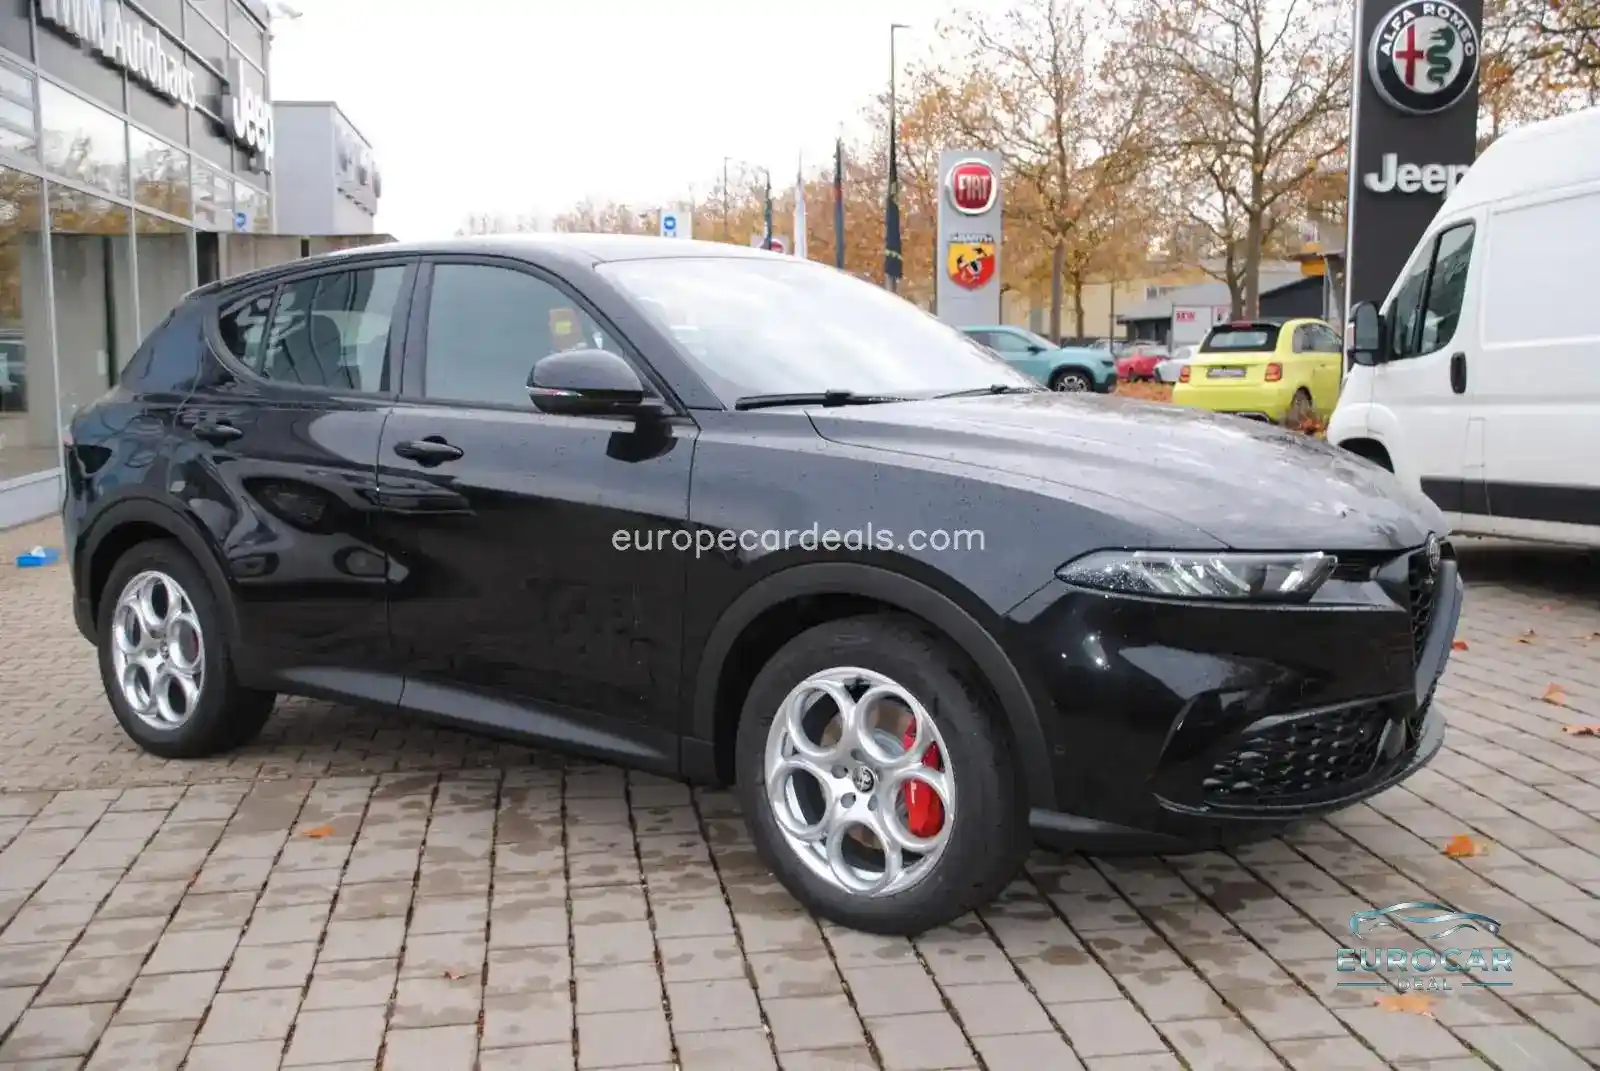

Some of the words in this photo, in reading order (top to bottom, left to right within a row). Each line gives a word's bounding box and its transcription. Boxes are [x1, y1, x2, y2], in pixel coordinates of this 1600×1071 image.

[111, 2, 197, 109] Autohaus
[1380, 10, 1416, 56] ALFA
[1423, 3, 1475, 57] ROMEO
[957, 174, 991, 199] FIAT
